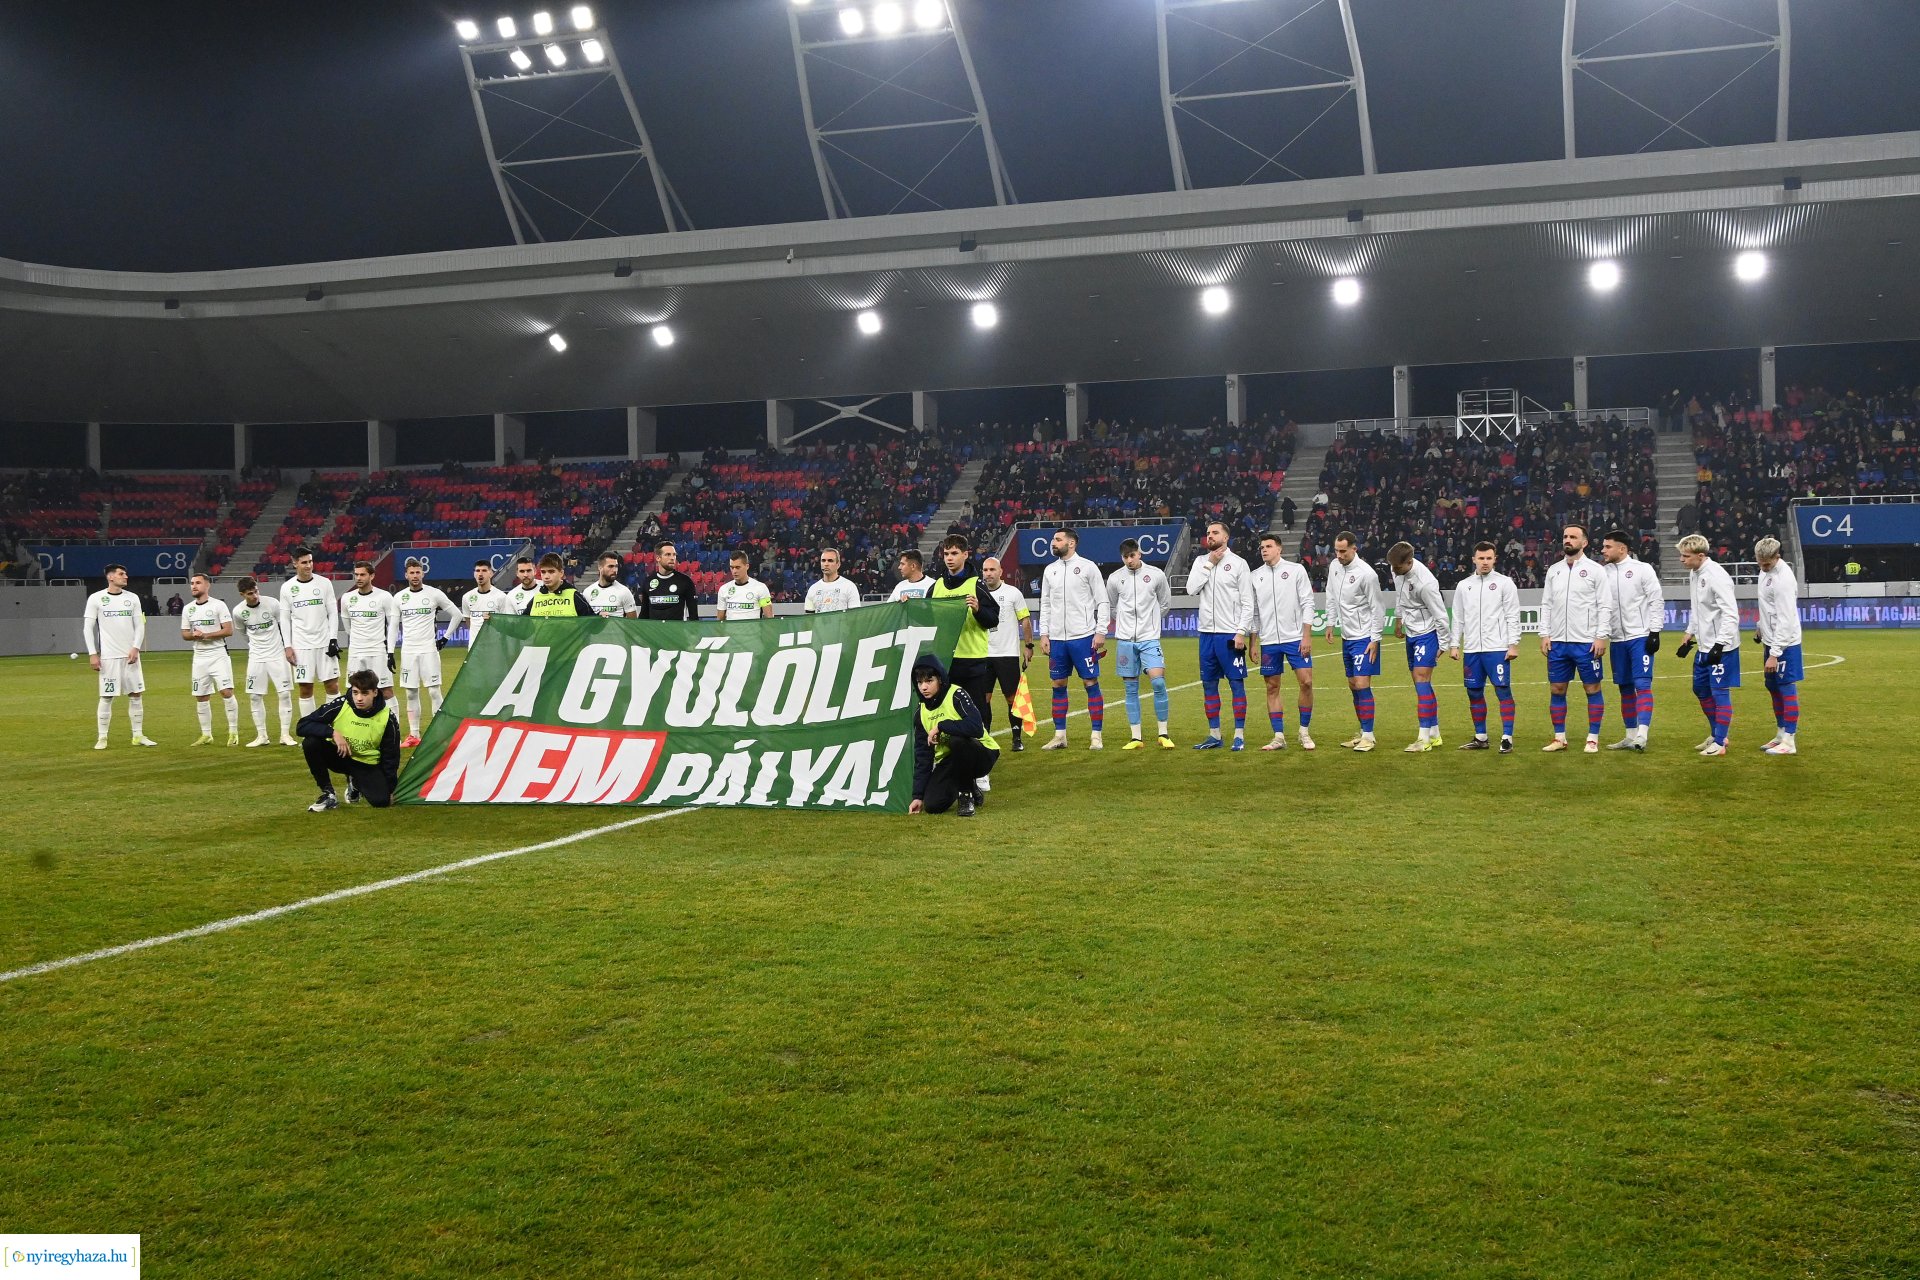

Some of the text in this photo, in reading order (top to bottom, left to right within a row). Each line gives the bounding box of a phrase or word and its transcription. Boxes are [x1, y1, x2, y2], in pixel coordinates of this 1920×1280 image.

[1811, 513, 1854, 538] C4
[1137, 533, 1170, 555] C5
[37, 552, 65, 571] D1
[156, 552, 187, 570] C8
[534, 598, 571, 608] macron
[1874, 606, 1920, 621] TAGJA!
[1414, 645, 1426, 656] 24
[1233, 656, 1244, 667] 44
[1354, 654, 1364, 666] 27
[1591, 660, 1600, 671] 16
[1642, 655, 1650, 666] 9
[296, 668, 306, 679] 29
[1496, 664, 1504, 675] 6
[1711, 664, 1725, 675] 23
[479, 626, 938, 727] A GYŰLÖLET
[105, 683, 115, 693] 23
[425, 725, 907, 806] NEM PÁLYA!
